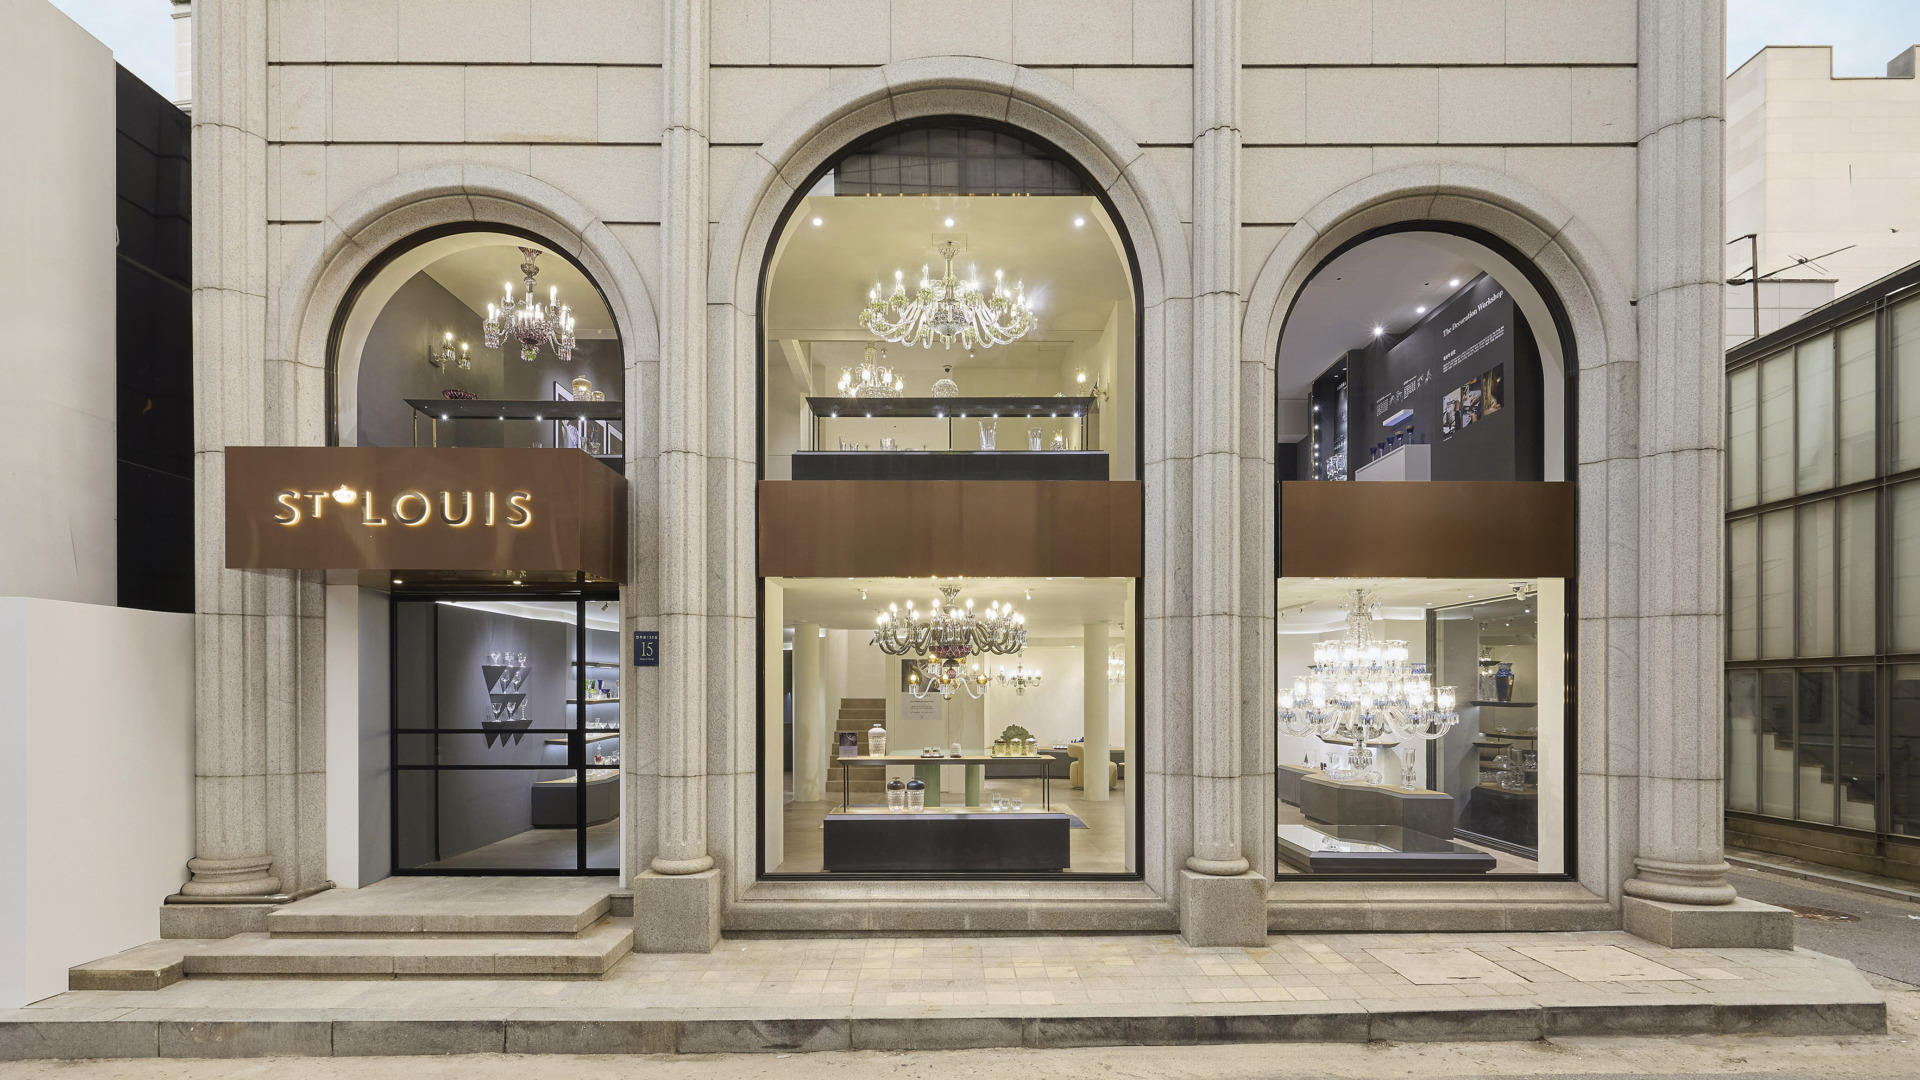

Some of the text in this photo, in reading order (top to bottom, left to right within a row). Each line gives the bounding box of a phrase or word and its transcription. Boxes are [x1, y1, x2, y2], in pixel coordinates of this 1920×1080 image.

[1442, 290, 1504, 337] The Decoration Workshop
[361, 489, 532, 527] LOUIS
[641, 641, 653, 657] 15
